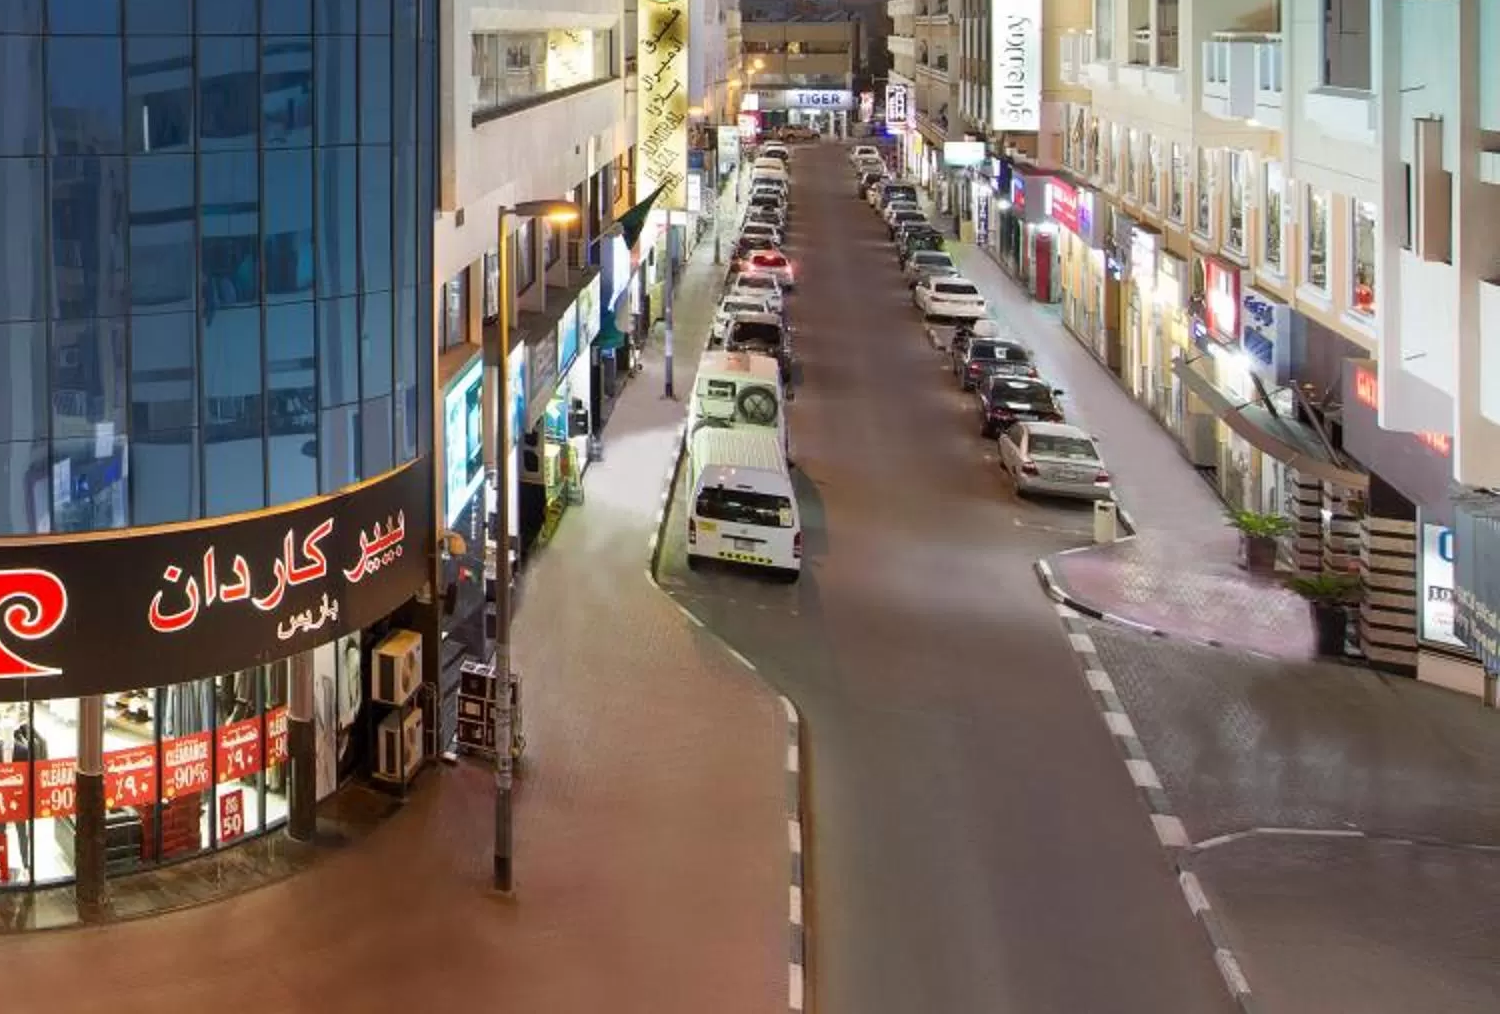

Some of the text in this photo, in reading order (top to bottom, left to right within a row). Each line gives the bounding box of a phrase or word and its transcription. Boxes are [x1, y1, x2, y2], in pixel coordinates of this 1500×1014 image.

[796, 93, 842, 105] TIGER
[148, 516, 336, 633] كاردان
[277, 592, 339, 641] باريس
[175, 761, 209, 790] 90%
[223, 813, 242, 836] 50
